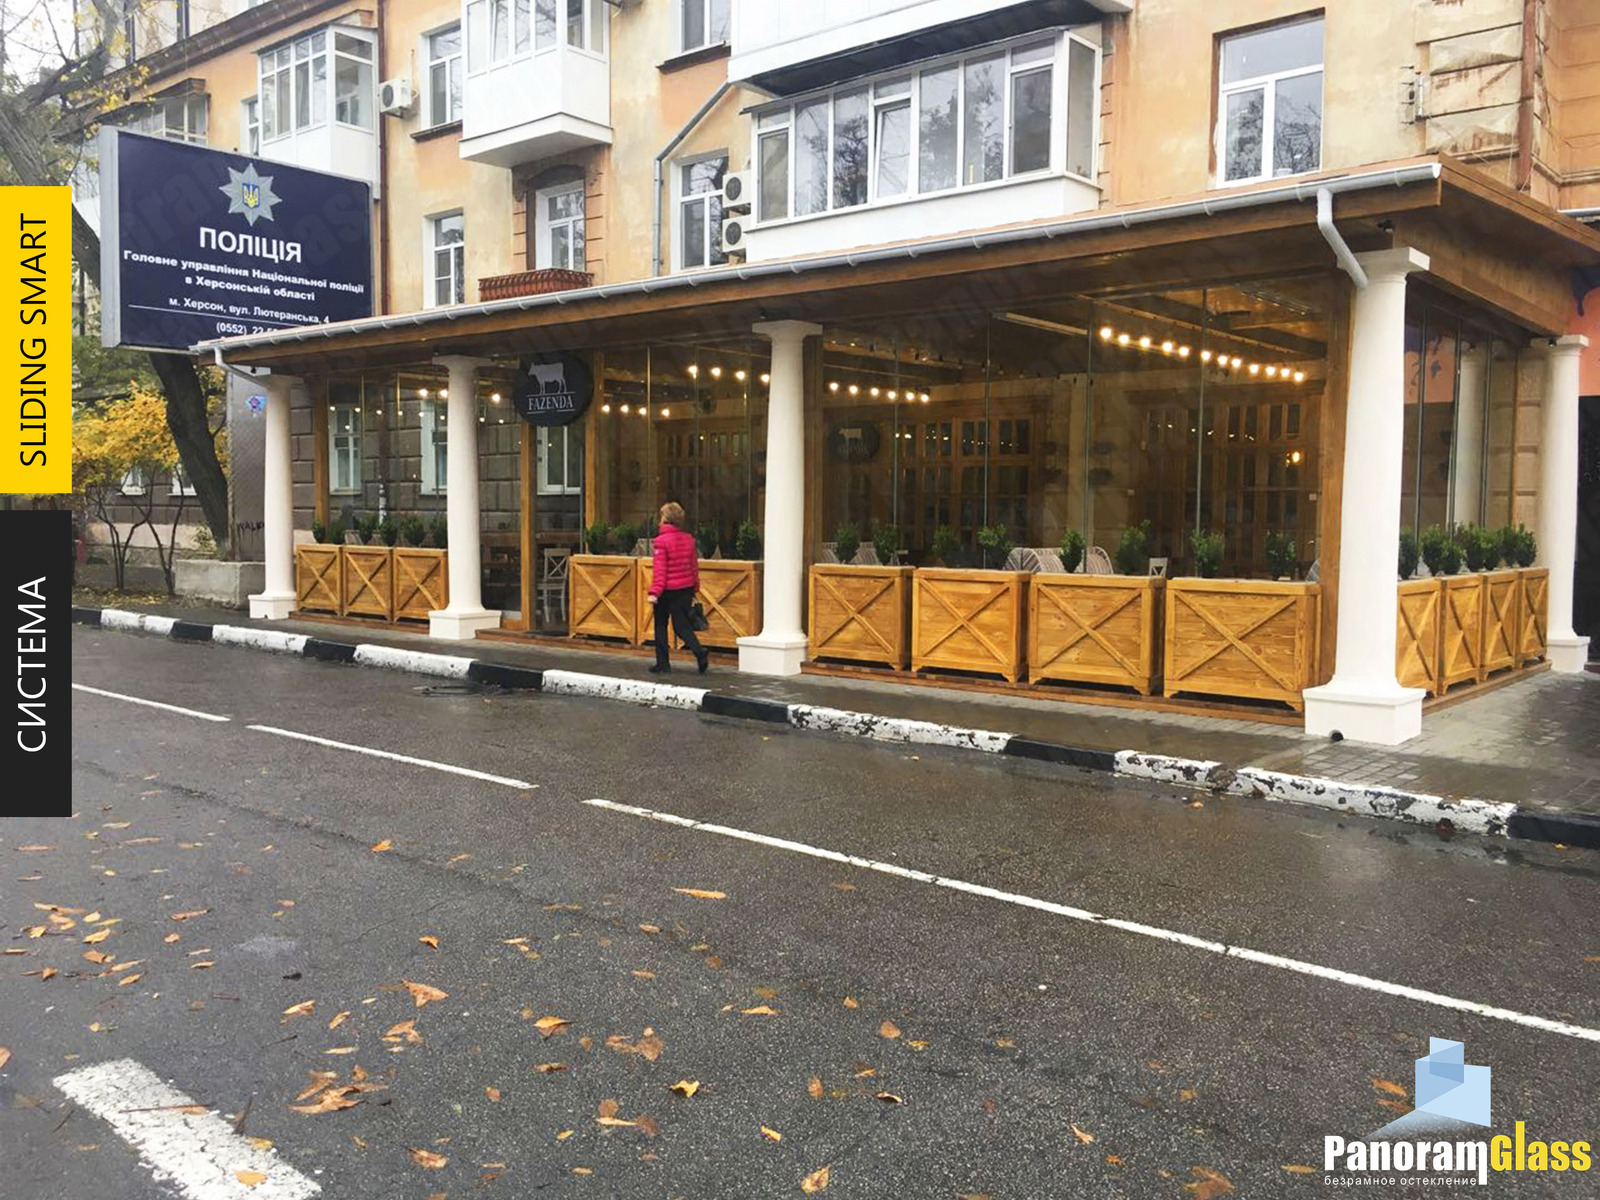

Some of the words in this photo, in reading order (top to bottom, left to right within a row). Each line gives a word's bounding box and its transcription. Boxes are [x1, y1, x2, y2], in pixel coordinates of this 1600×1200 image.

[199, 226, 302, 264] ПОЛІЦІЯ
[123, 250, 178, 267] Головне
[181, 260, 249, 277] управління
[252, 268, 327, 289] Національної
[329, 282, 364, 294] поліції
[195, 276, 271, 296] Херсонській
[273, 288, 316, 301] області
[183, 297, 227, 313] Херсон,
[229, 305, 251, 316] вул.
[216, 322, 248, 336] (0552)
[527, 395, 574, 411] FAZENDA
